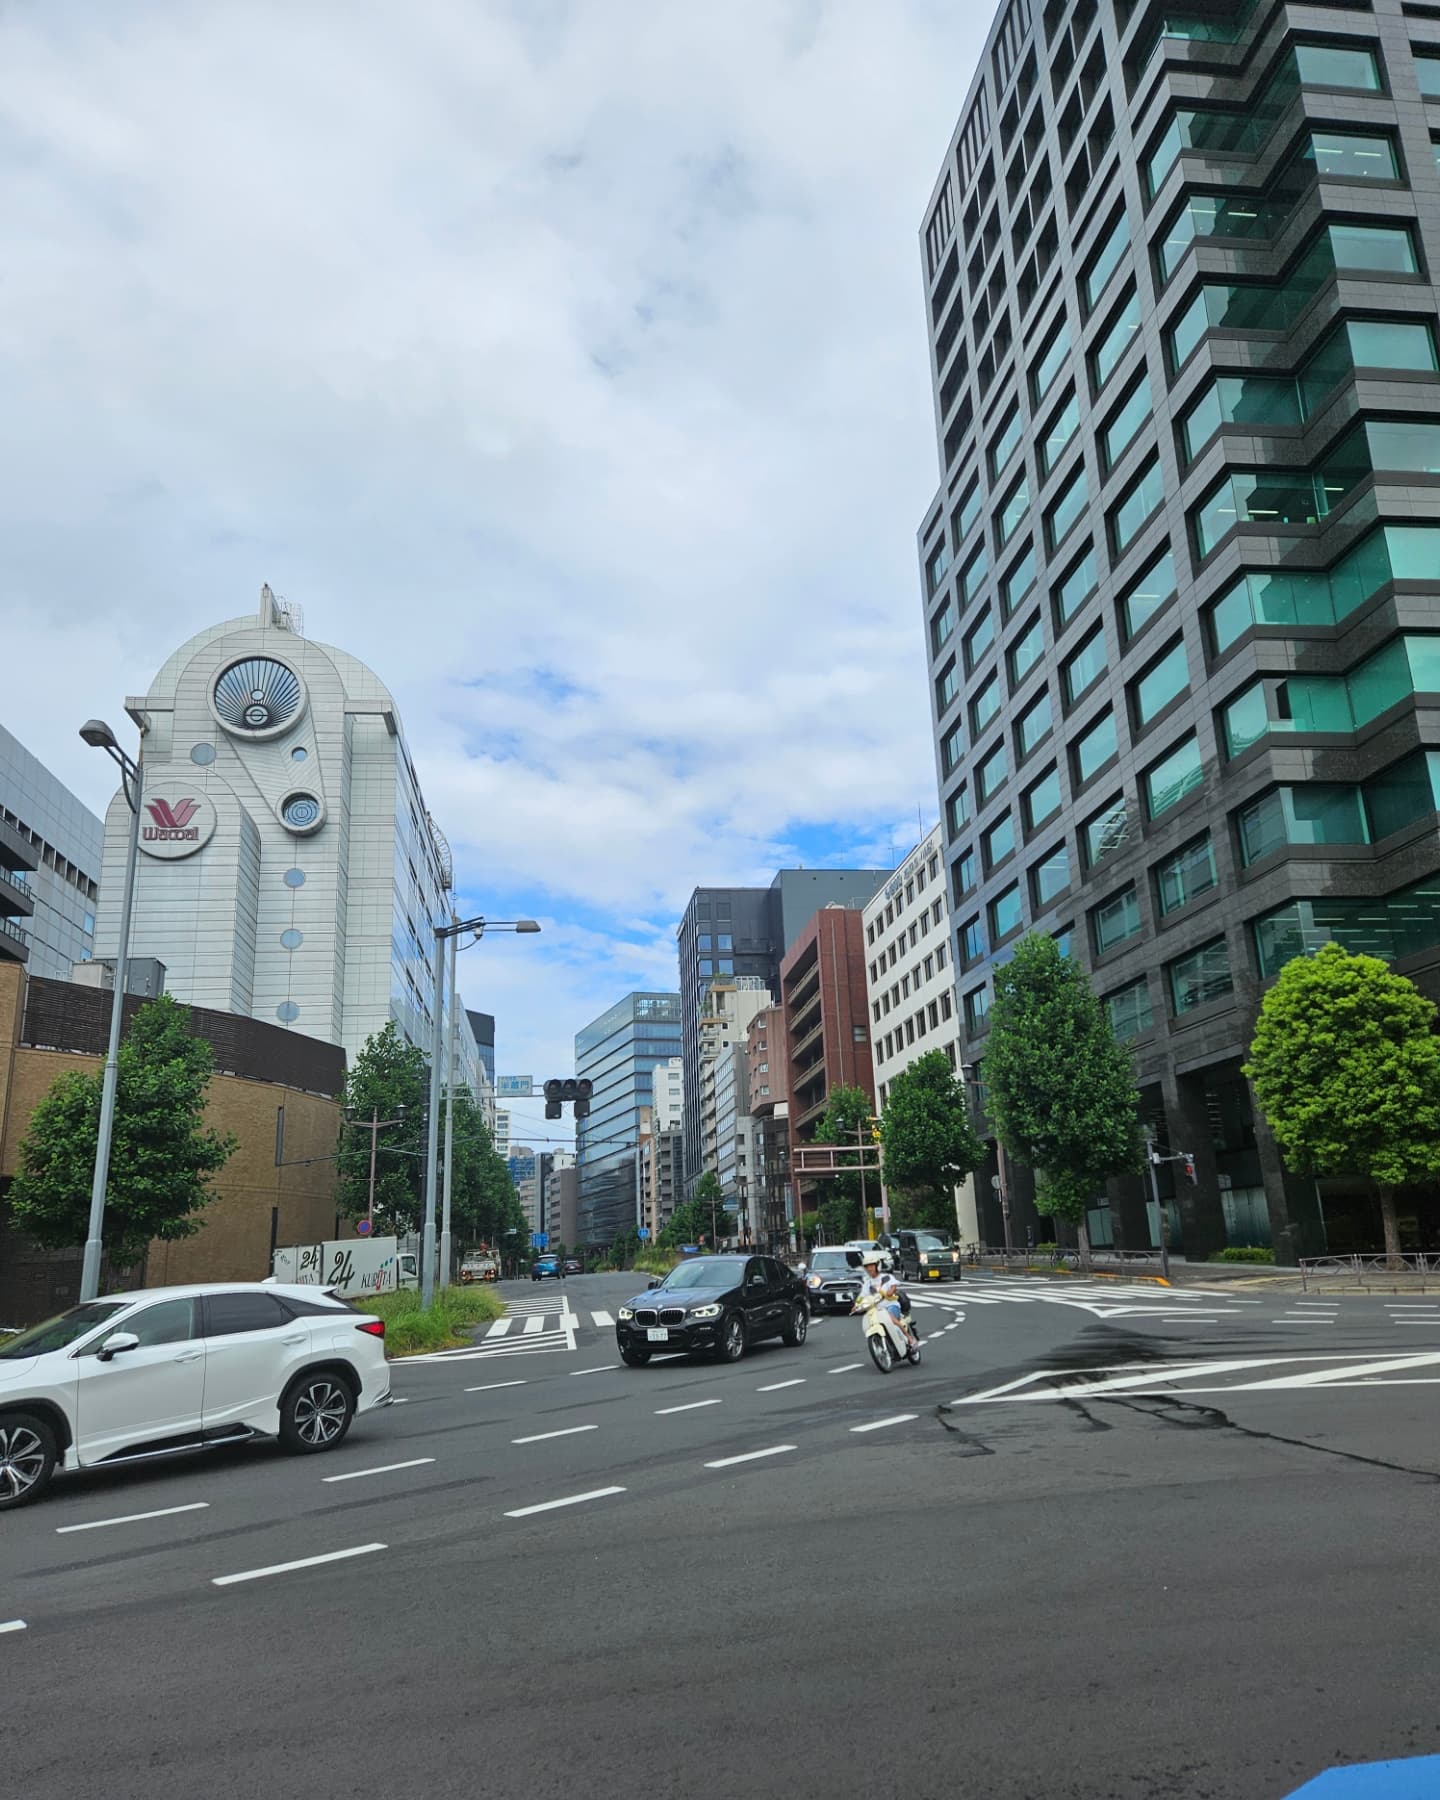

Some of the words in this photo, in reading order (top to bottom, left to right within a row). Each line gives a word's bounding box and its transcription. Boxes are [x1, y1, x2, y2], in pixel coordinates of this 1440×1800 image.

[143, 827, 199, 840] Wacoal
[300, 1246, 319, 1270] 24
[327, 1250, 355, 1290] 24
[361, 1269, 392, 1291] KUBOTA
